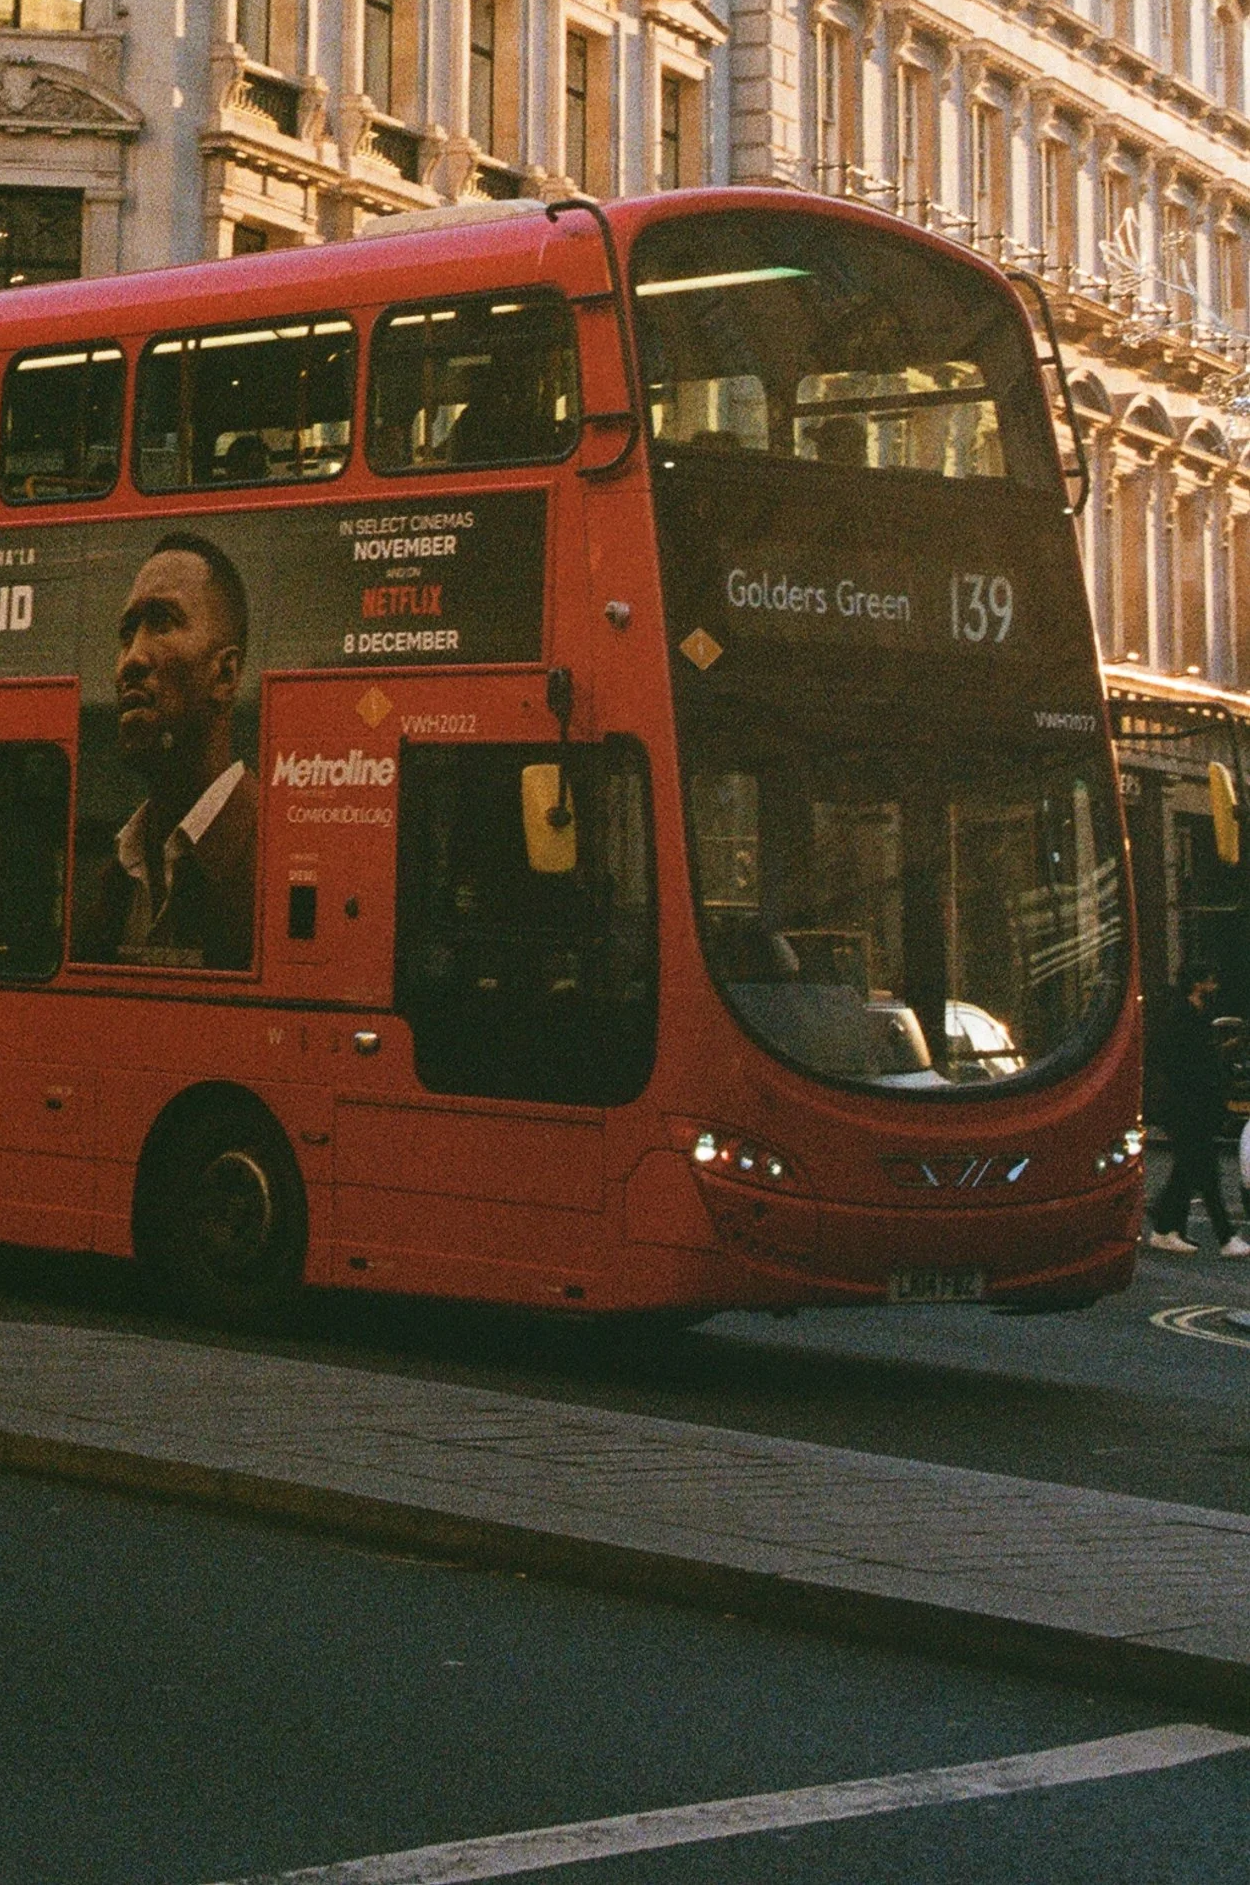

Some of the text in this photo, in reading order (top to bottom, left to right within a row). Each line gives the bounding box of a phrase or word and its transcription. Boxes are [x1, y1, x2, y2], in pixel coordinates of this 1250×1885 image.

[339, 511, 474, 536] IN SELECT CINEMAS
[354, 535, 457, 561] NOVEMBER
[361, 584, 443, 619] NETFLIX
[727, 569, 911, 621] Golders Green
[951, 573, 1014, 643] 139
[344, 629, 459, 653] 8 DECEMBER
[401, 714, 477, 734] VWH2022
[271, 748, 396, 787] Metroline
